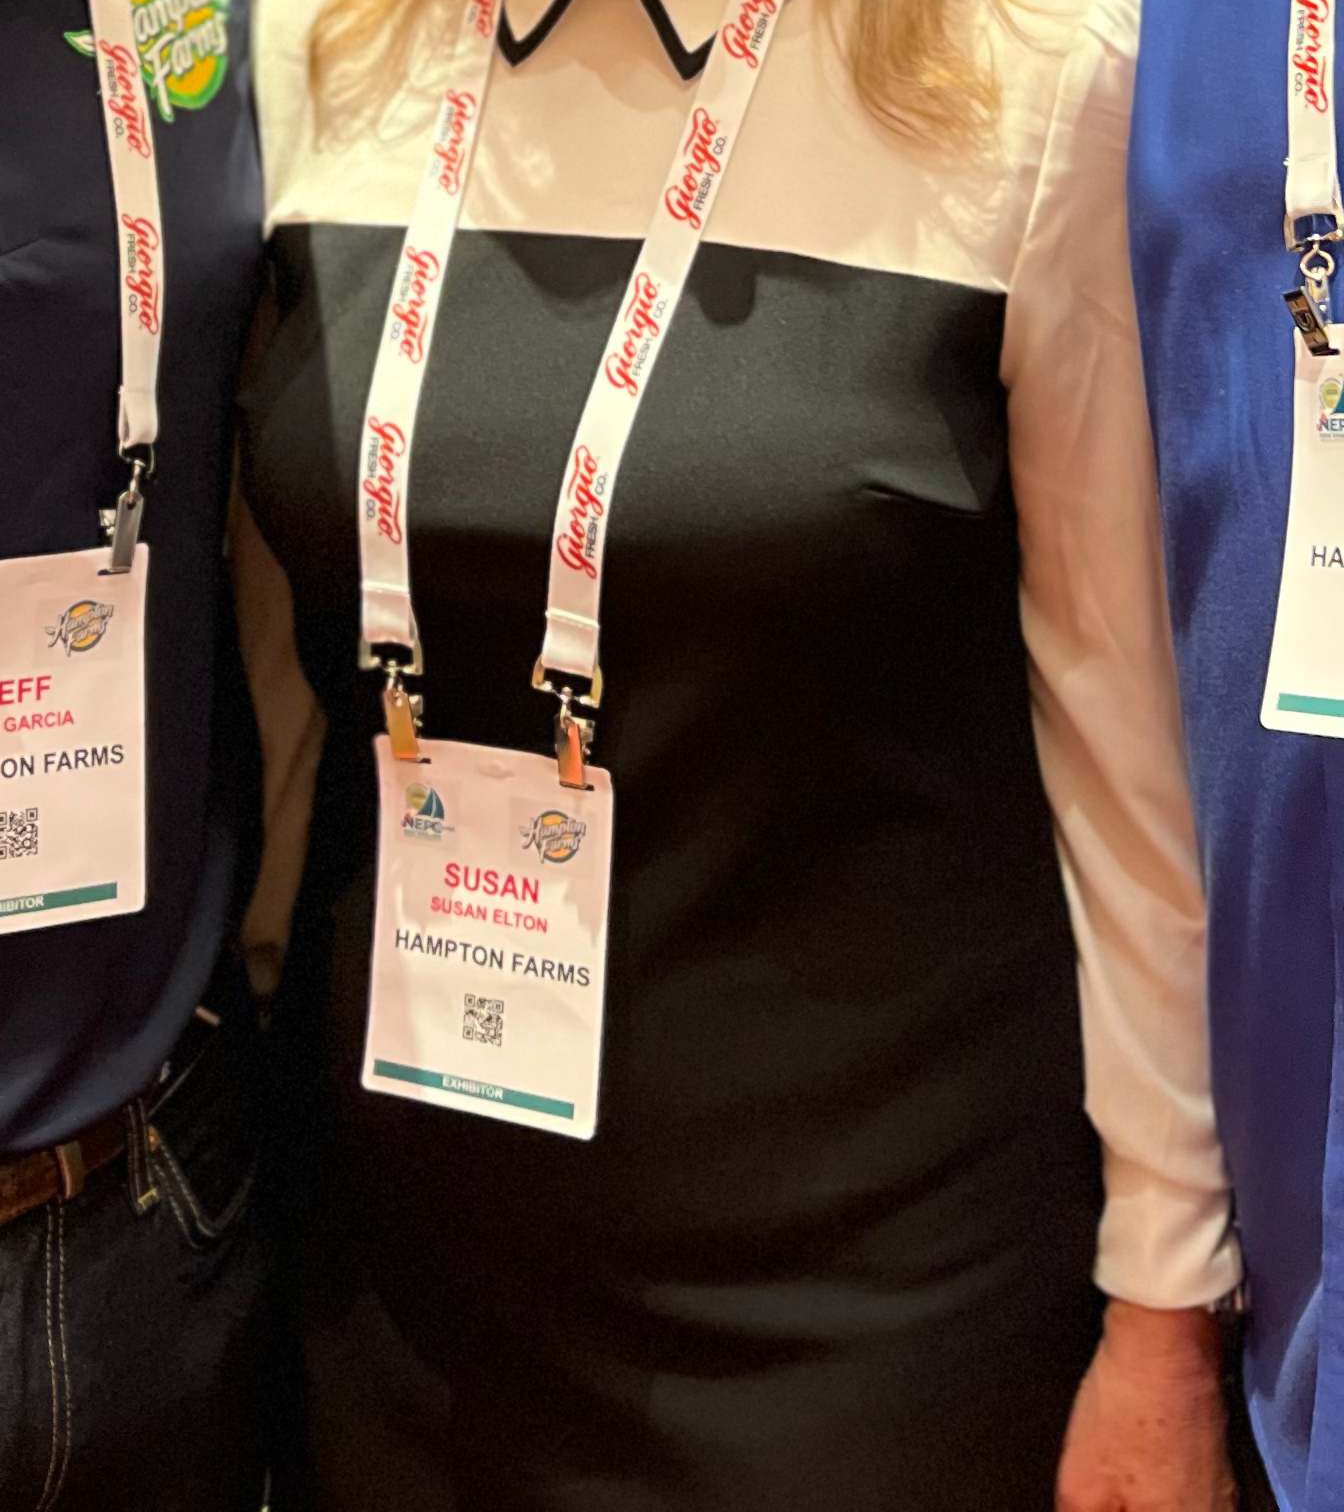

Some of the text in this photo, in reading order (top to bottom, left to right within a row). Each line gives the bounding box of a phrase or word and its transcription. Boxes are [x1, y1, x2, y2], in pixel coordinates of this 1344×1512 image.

[750, 12, 770, 51] FRESH
[99, 40, 151, 159] Giorgio
[106, 59, 119, 98] FRESH
[434, 89, 477, 196] Giorgio
[665, 107, 721, 230] Giorgio
[693, 172, 715, 211] FRESH
[121, 213, 159, 336] Giorgio
[126, 233, 137, 274] FRESH
[392, 245, 440, 364] Giorgio
[605, 272, 660, 397] Giorgio
[631, 337, 653, 377] FRESH
[367, 436, 380, 479] FRESH
[362, 415, 407, 545] Giorgio
[556, 444, 604, 580] Giorgio
[584, 516, 599, 559] FRESH
[3, 710, 75, 733] GARCIA
[44, 744, 125, 774] FARMS
[444, 862, 540, 904] SUSAN
[431, 896, 548, 933] SUSAN ELTON
[395, 929, 591, 987] HAMPTON FARMS
[442, 1074, 504, 1101] EXHIBITOR
